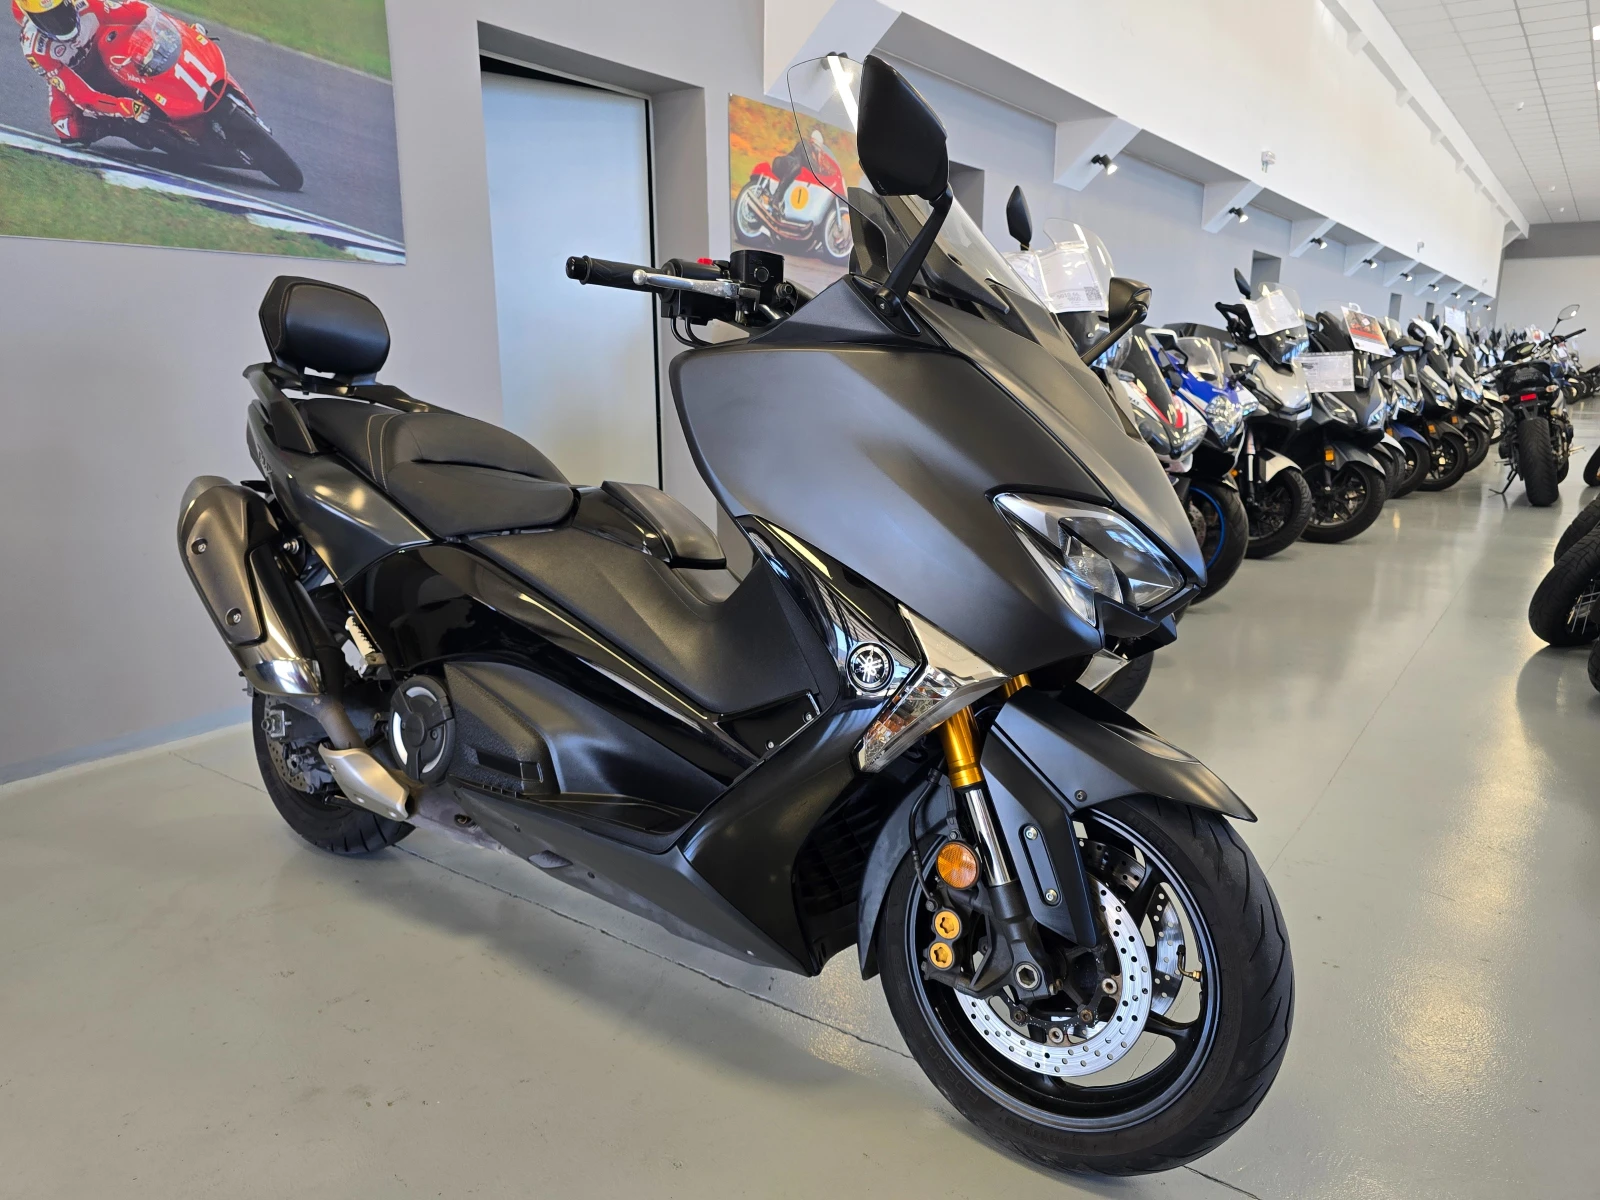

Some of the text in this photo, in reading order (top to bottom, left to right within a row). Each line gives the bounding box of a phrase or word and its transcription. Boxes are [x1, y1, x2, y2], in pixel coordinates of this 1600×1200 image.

[174, 49, 217, 102] 11
[797, 188, 802, 204] 1
[927, 1045, 980, 1104] ROSSO
